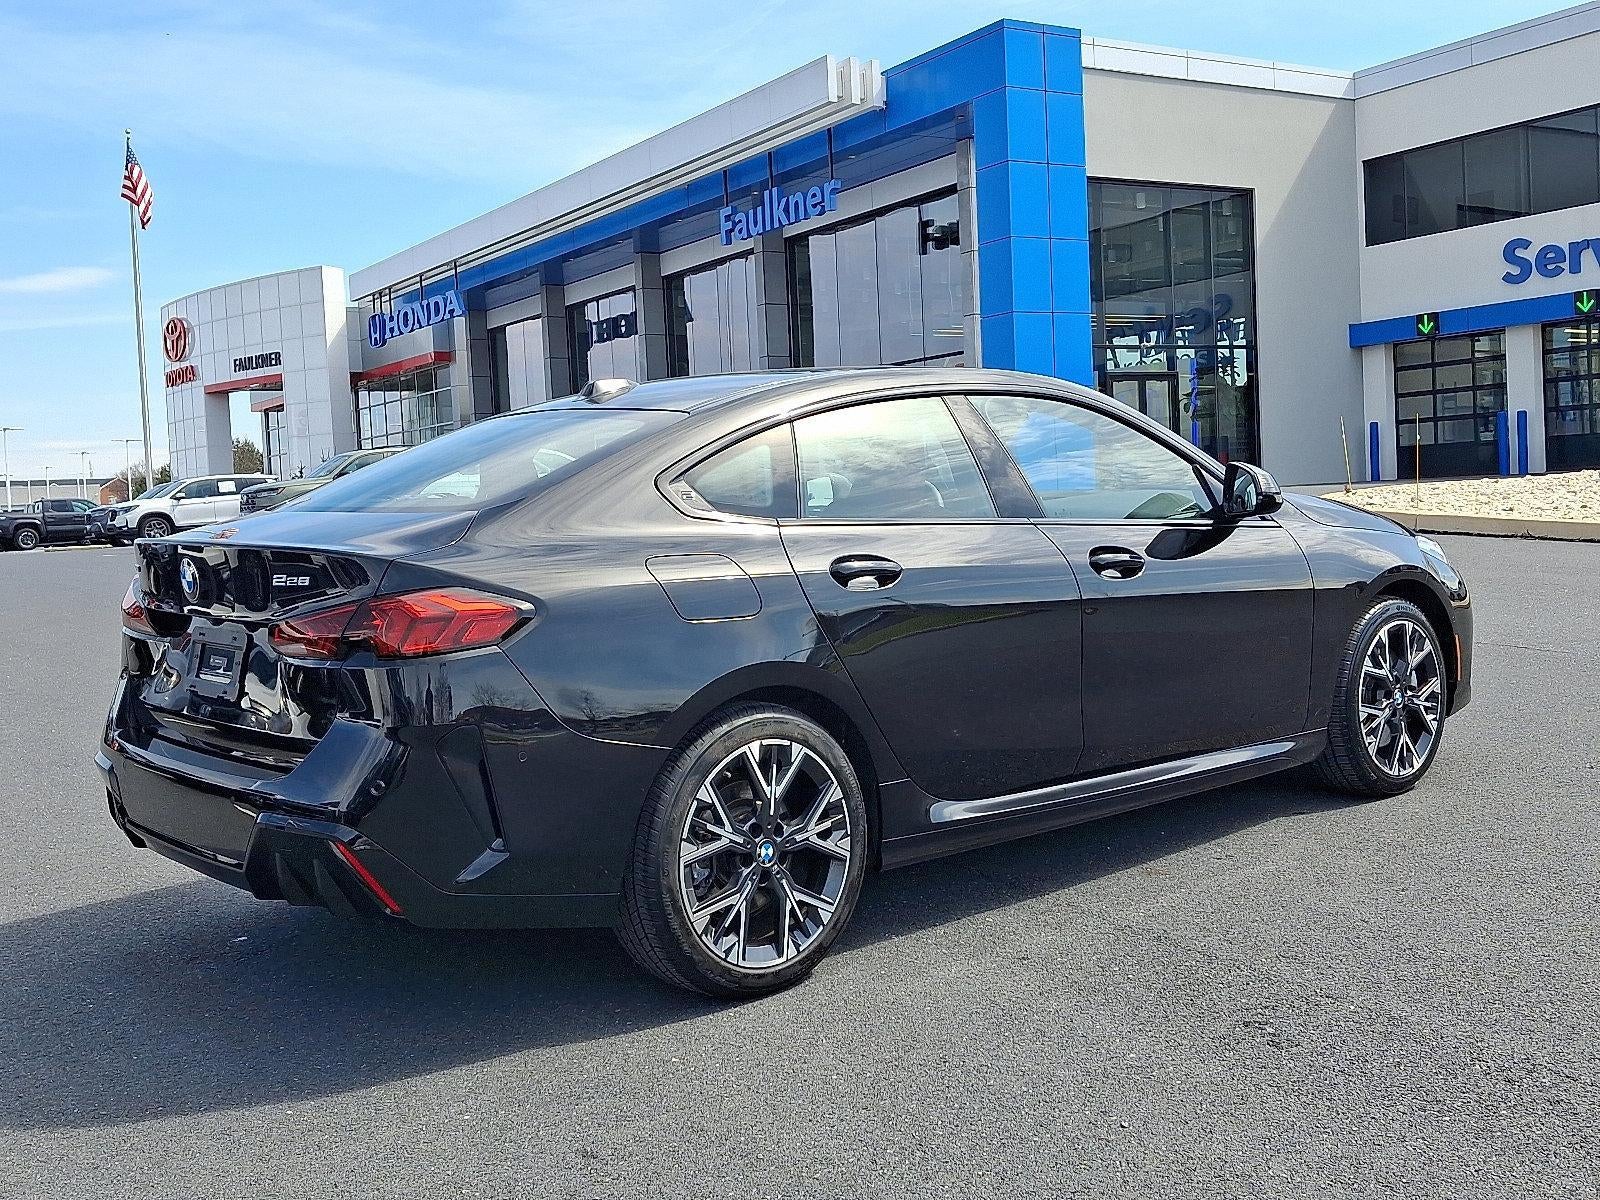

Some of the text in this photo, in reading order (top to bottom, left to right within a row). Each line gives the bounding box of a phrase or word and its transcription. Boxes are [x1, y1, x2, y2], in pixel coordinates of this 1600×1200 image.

[720, 180, 842, 246] Faulkner
[385, 290, 464, 338] HONDA
[233, 352, 281, 373] FAULKNER
[164, 365, 196, 388] TOYOTA
[273, 575, 310, 586] 228
